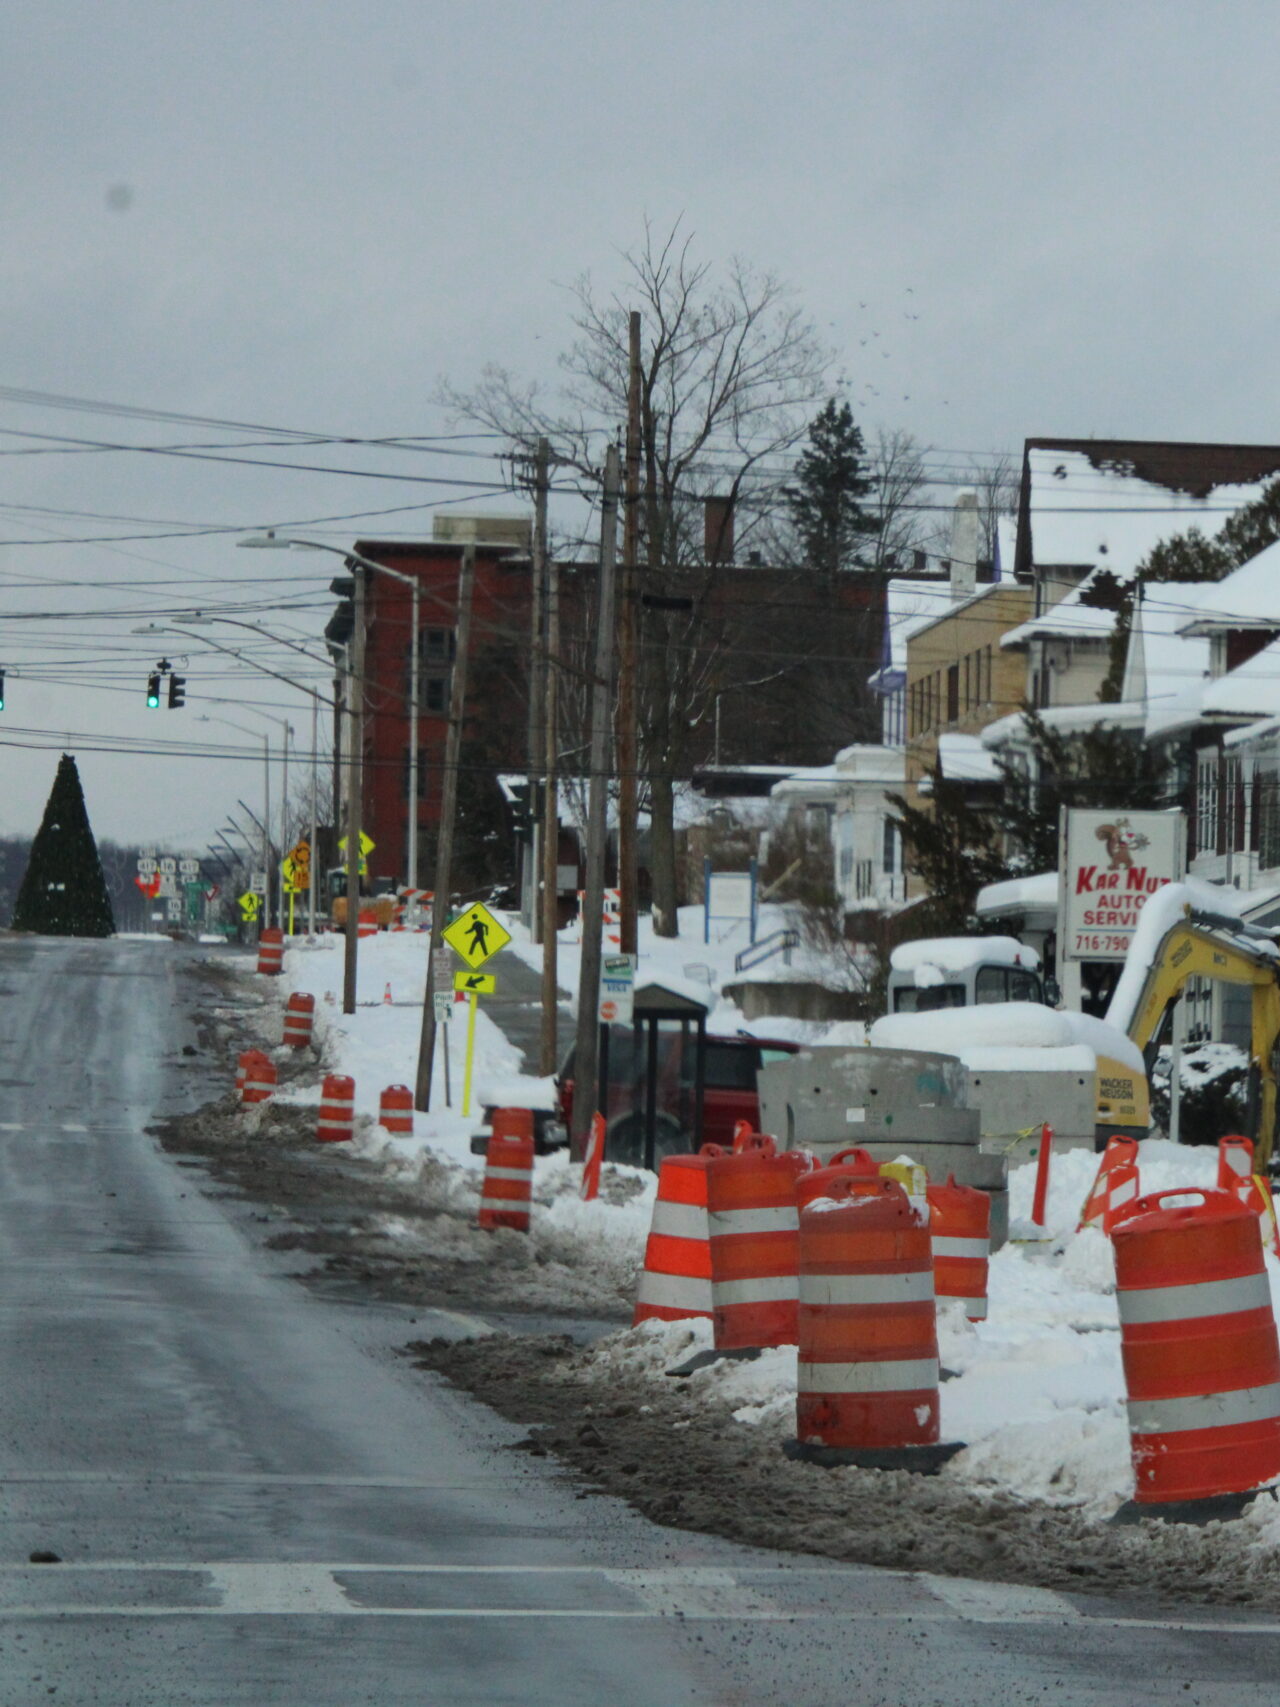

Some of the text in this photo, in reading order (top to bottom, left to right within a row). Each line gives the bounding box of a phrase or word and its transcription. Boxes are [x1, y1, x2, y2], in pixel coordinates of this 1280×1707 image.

[1097, 894, 1148, 909] AUTO
[1083, 910, 1137, 926] SERVI
[1076, 935, 1130, 951] 716-790
[607, 984, 627, 992] VISA
[1100, 1078, 1133, 1088] WACKER
[1100, 1088, 1133, 1099] NEUSON
